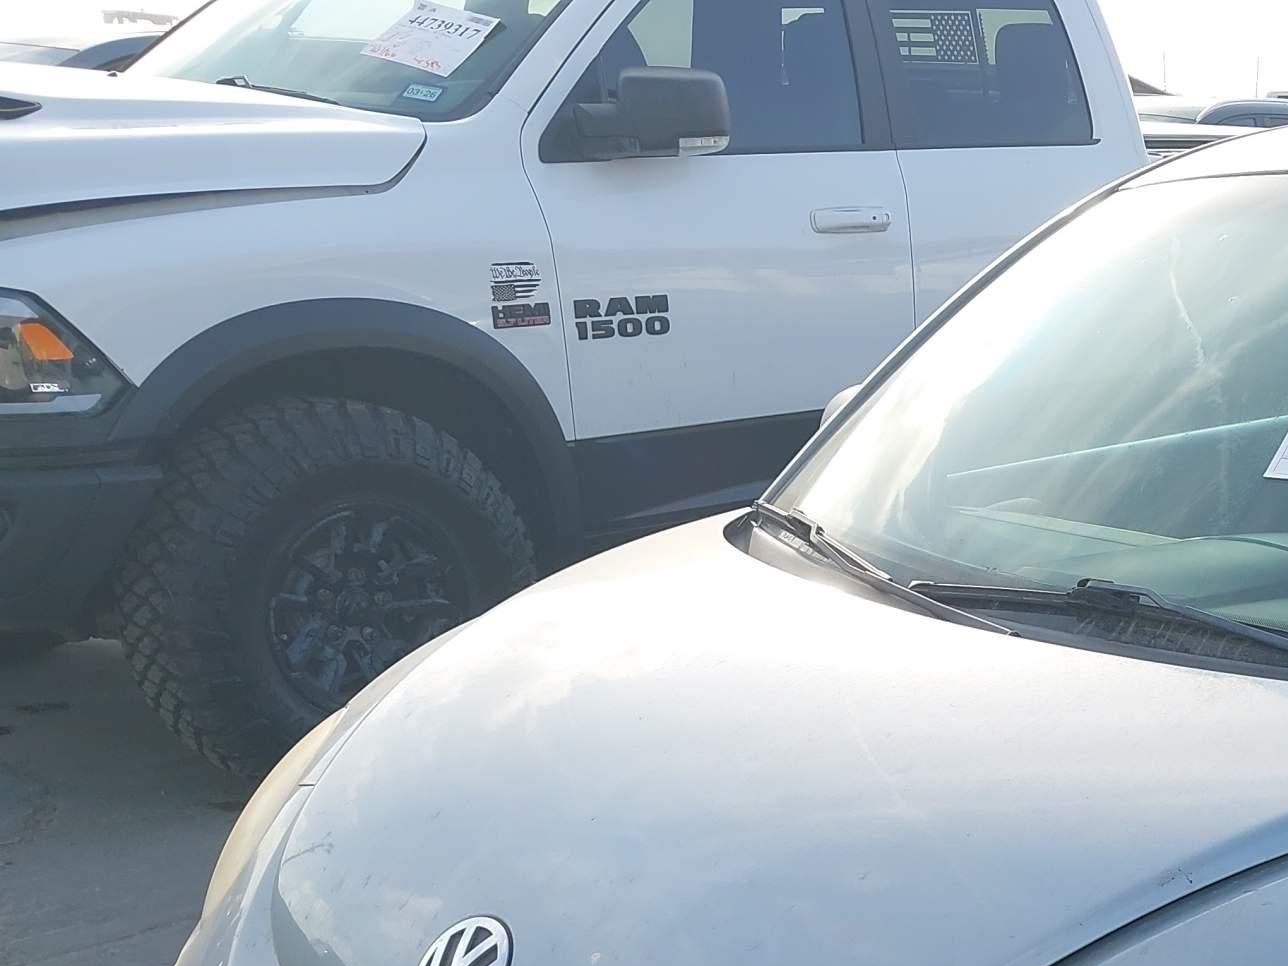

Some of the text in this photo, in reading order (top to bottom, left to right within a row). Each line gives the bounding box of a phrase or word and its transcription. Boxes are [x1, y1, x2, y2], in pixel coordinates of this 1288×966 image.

[408, 15, 482, 40] 44739317
[573, 294, 669, 319] RAM
[575, 315, 671, 341] 1500
